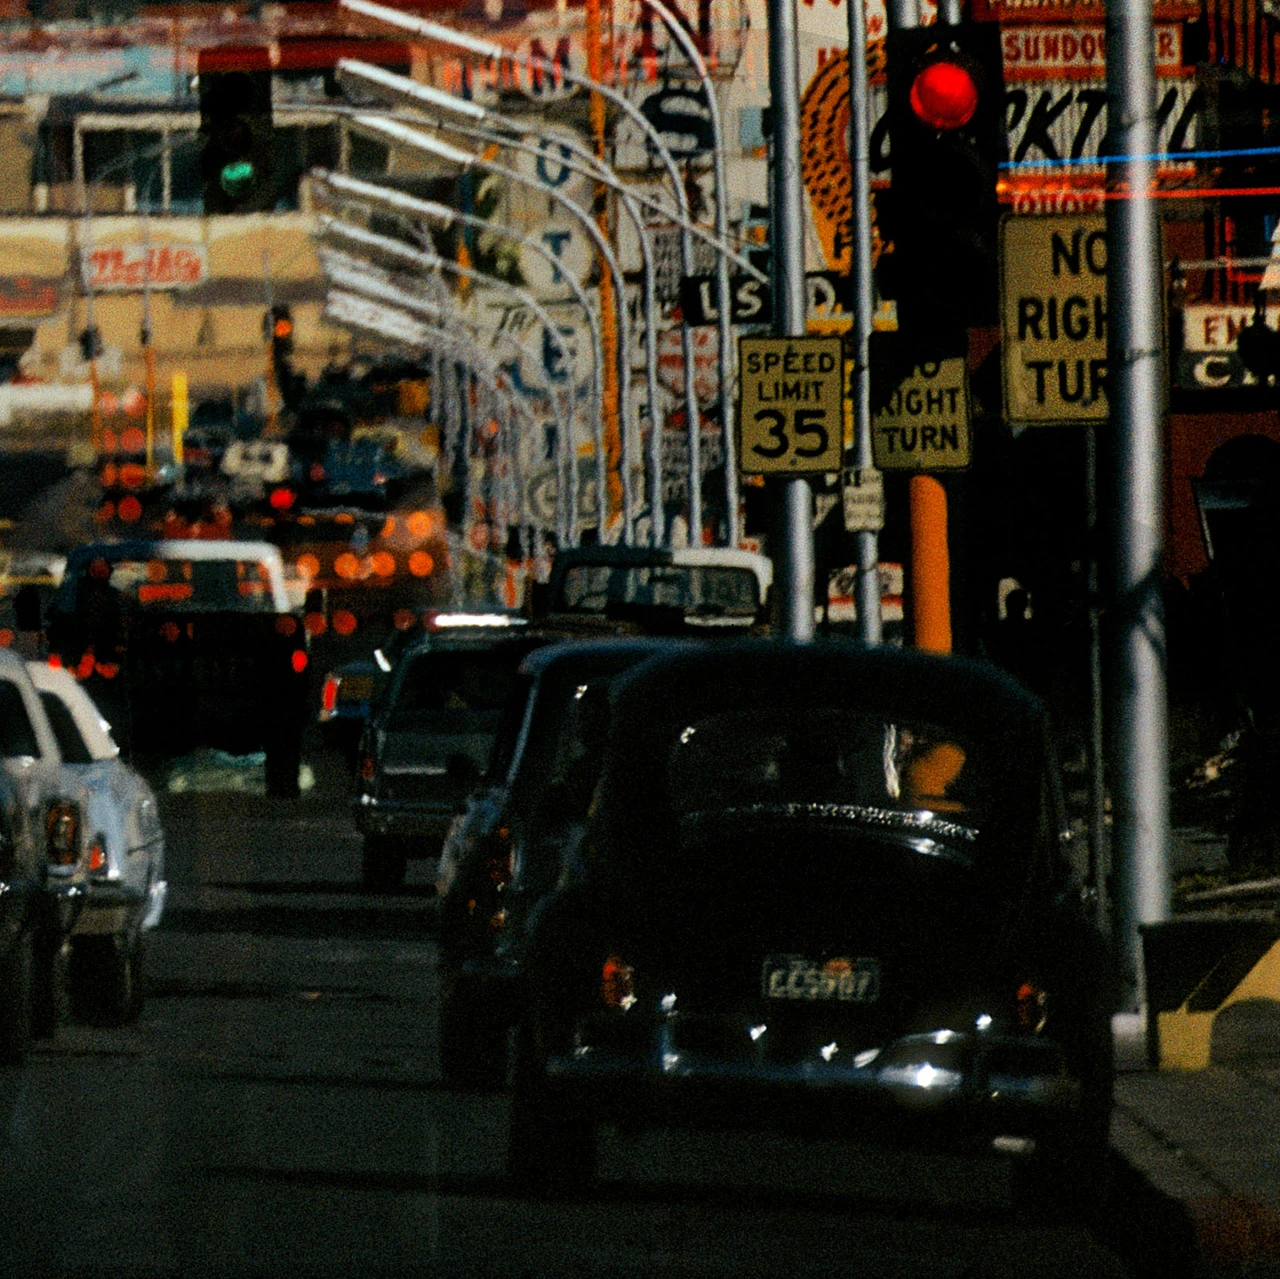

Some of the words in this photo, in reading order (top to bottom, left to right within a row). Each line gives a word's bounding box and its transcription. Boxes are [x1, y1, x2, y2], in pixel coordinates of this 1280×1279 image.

[1003, 32, 1176, 62] SUNDOR
[1018, 295, 1107, 342] RIG
[746, 352, 835, 375] SPEED
[757, 380, 825, 403] LIMIT
[1027, 359, 1107, 405] TU
[753, 409, 829, 459] 35
[882, 425, 959, 452] TURN
